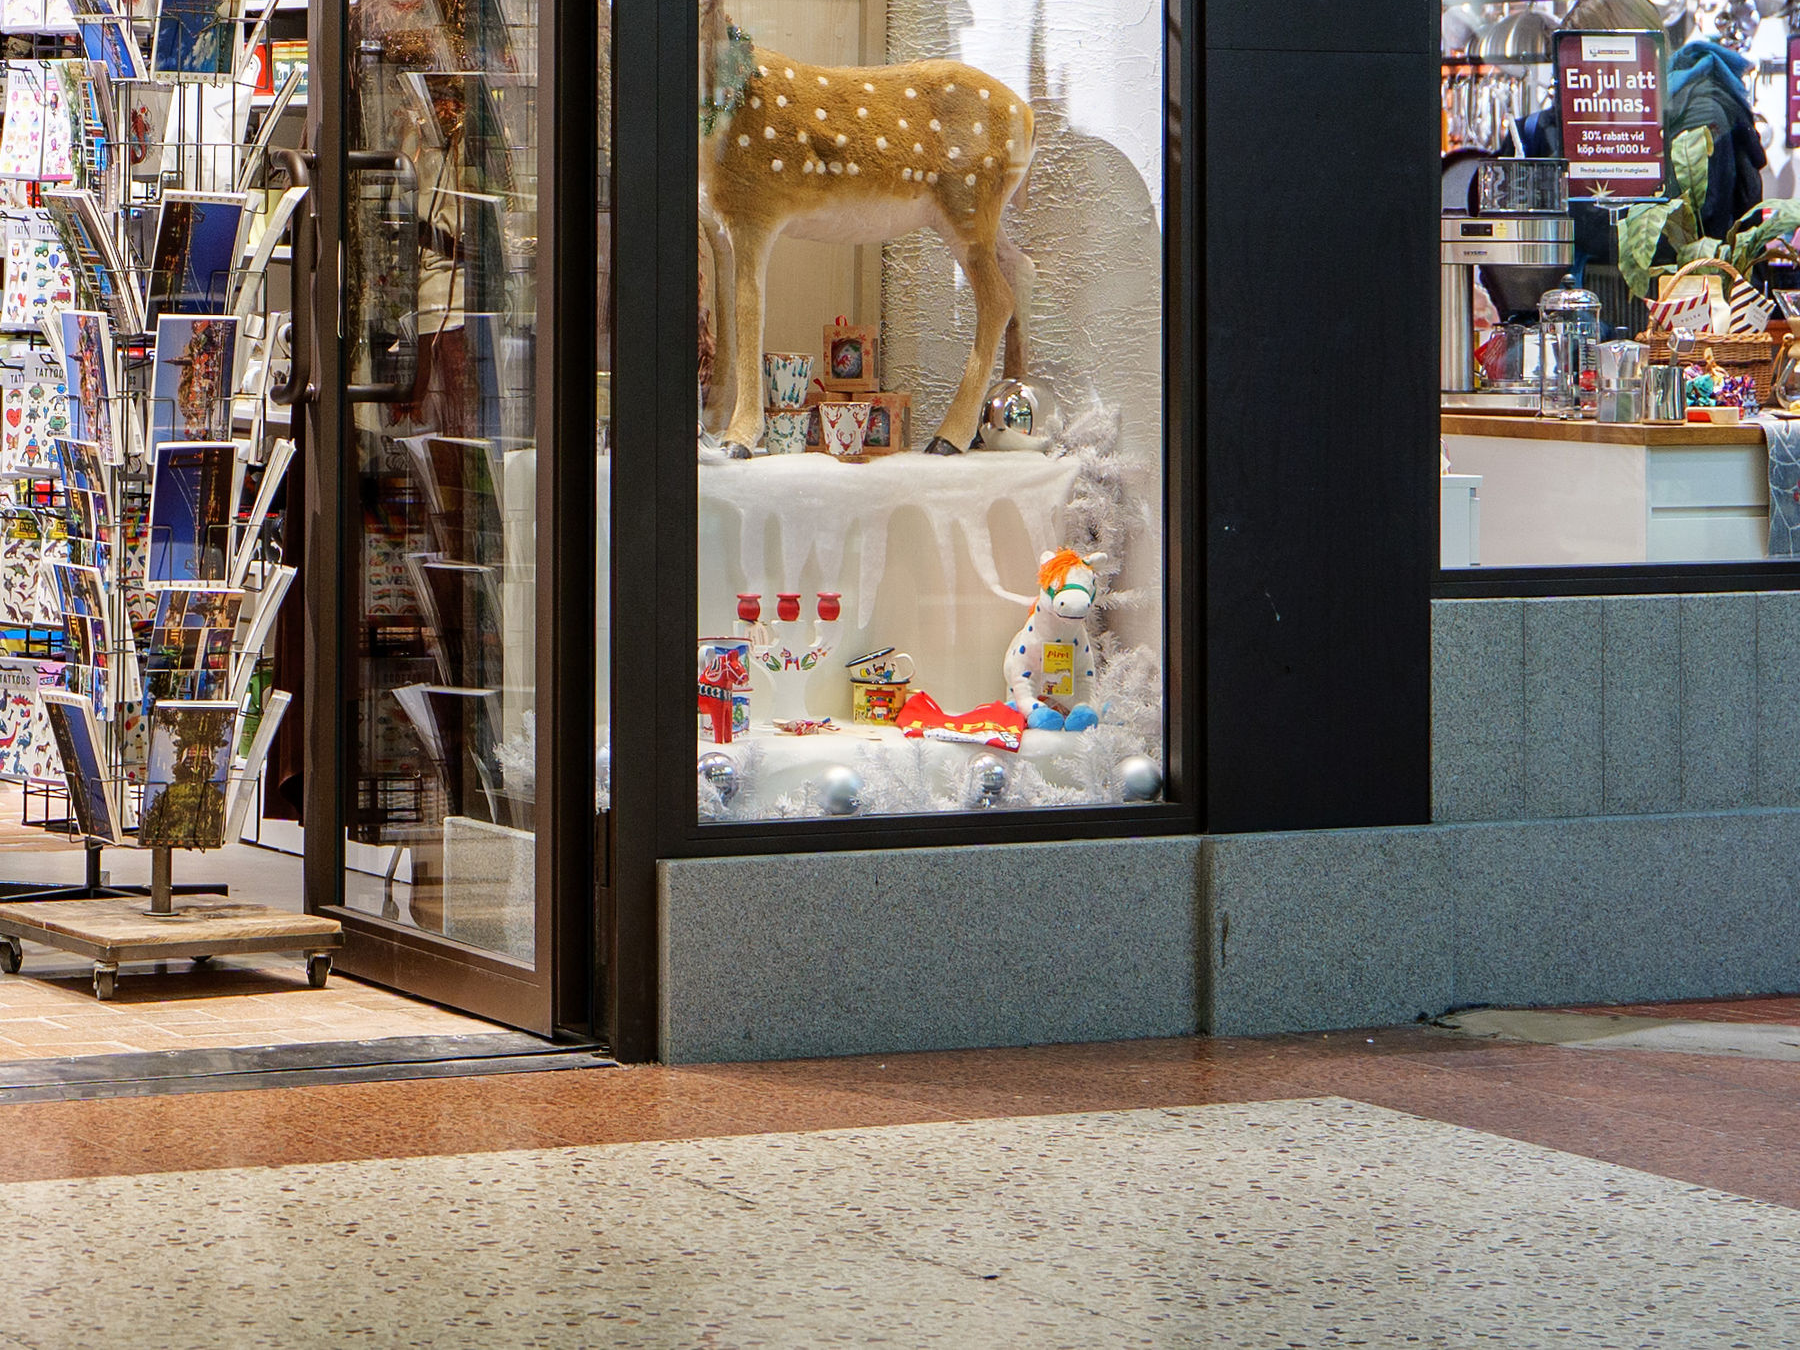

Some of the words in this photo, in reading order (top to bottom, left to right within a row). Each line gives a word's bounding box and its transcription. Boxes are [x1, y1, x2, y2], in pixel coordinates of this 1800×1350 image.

[1566, 68, 1592, 89] En
[1597, 68, 1621, 95] jul
[1626, 70, 1657, 90] att
[1573, 92, 1651, 113] minnas.
[1582, 130, 1602, 141] 30%
[1602, 130, 1630, 141] rabatt
[1630, 130, 1645, 141] vid
[1577, 144, 1595, 156] köp
[1595, 144, 1615, 155] över
[1616, 144, 1639, 155] 1000
[1640, 144, 1651, 155] kr
[0, 673, 31, 686] TATTOOS
